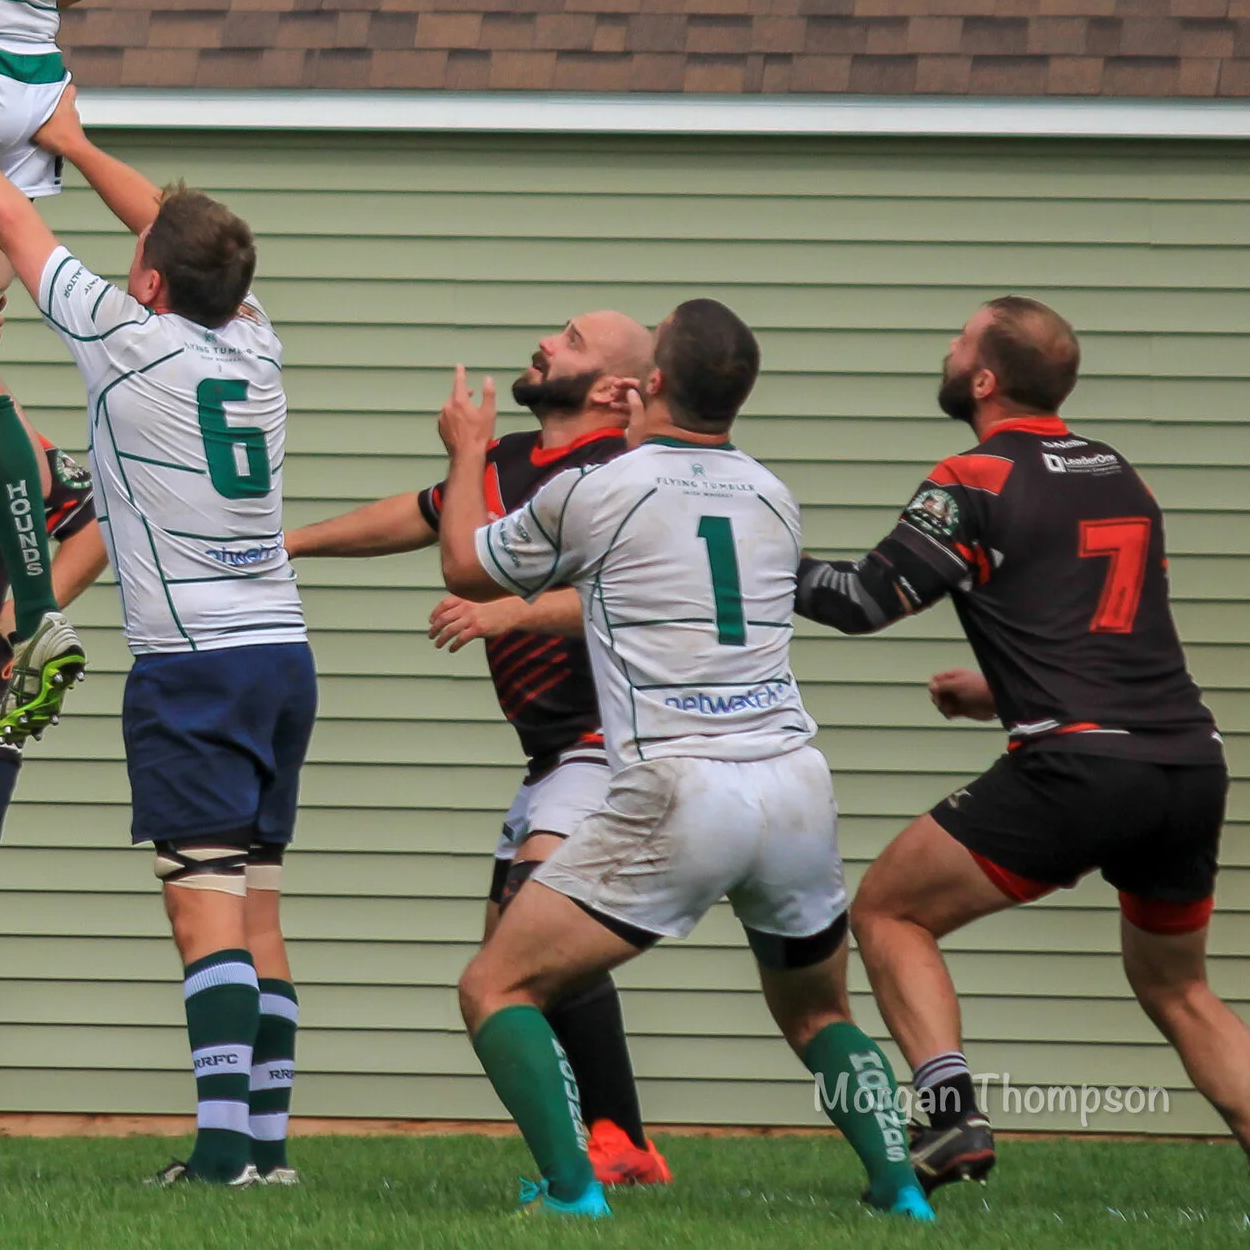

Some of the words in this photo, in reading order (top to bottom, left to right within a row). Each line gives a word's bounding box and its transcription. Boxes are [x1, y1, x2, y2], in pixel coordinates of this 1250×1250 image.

[196, 378, 271, 499] 6
[6, 479, 44, 576] HOUNDS
[697, 516, 746, 646] 1
[1078, 516, 1152, 634] 7
[849, 1049, 908, 1163] HOUNDS
